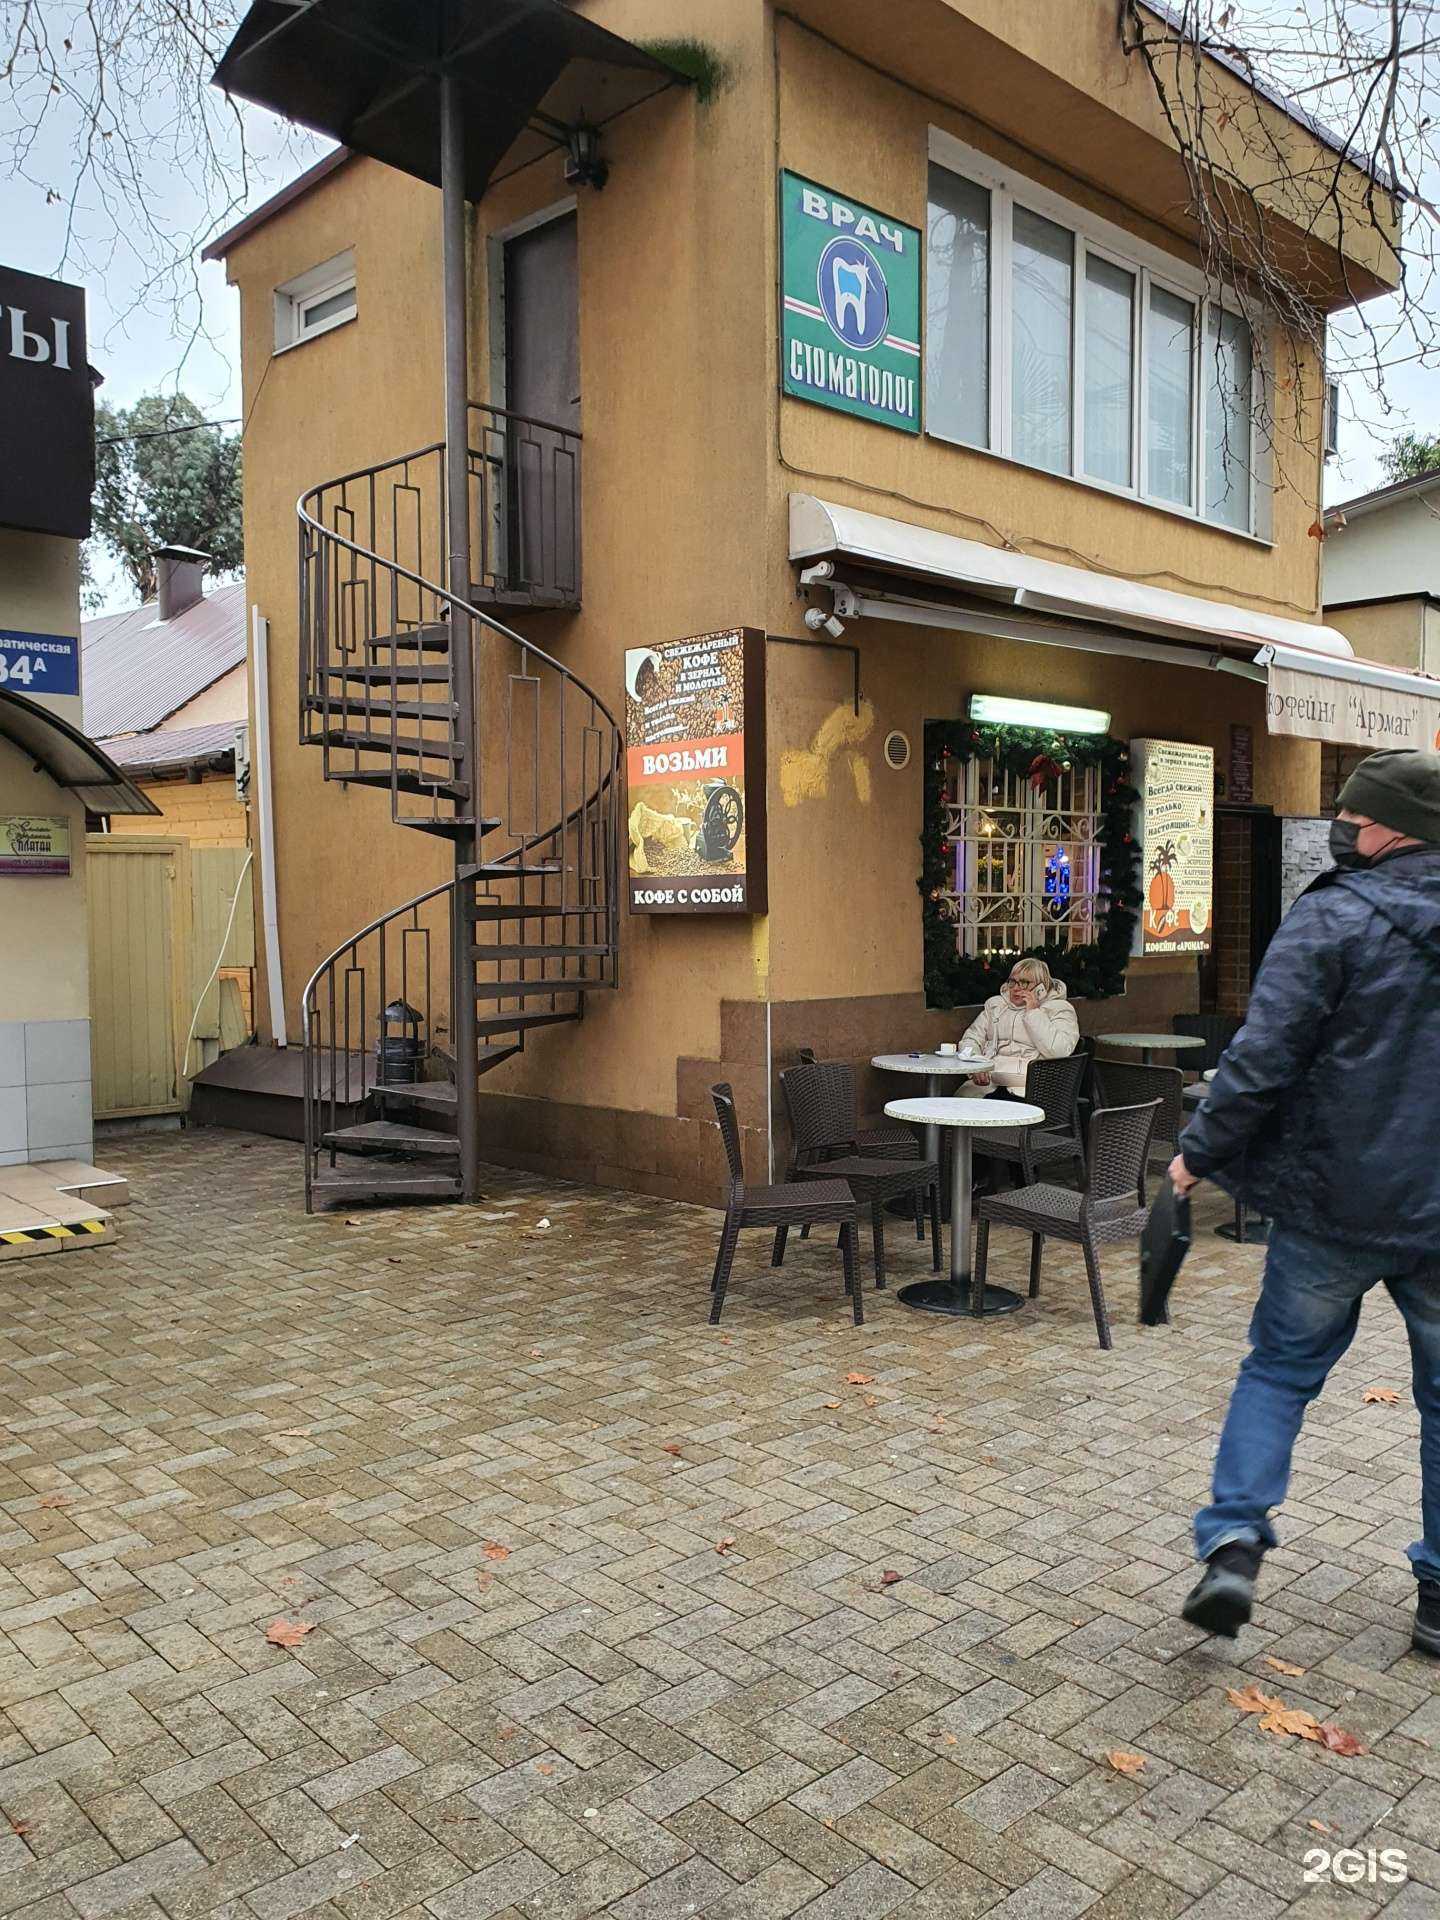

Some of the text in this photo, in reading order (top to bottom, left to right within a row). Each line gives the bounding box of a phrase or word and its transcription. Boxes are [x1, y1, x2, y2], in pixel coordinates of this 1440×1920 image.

[802, 188, 903, 253] ВРАЧ
[0, 304, 72, 370] Ы
[664, 635, 739, 658] СВЕЖЕЖАРЕНЫЙ
[683, 652, 718, 669] КОФЕ
[681, 667, 721, 682] В ЗЕРНАХ
[676, 676, 727, 693] И МОЛОТЫЙ
[642, 746, 728, 775] ВОЗЬМИ
[1148, 782, 1202, 796] Всегда свежий
[1148, 802, 1182, 816] и только
[634, 884, 743, 905] КОФЕ С СОБОЙ
[1145, 940, 1176, 953] КОФЕЙНЯ
